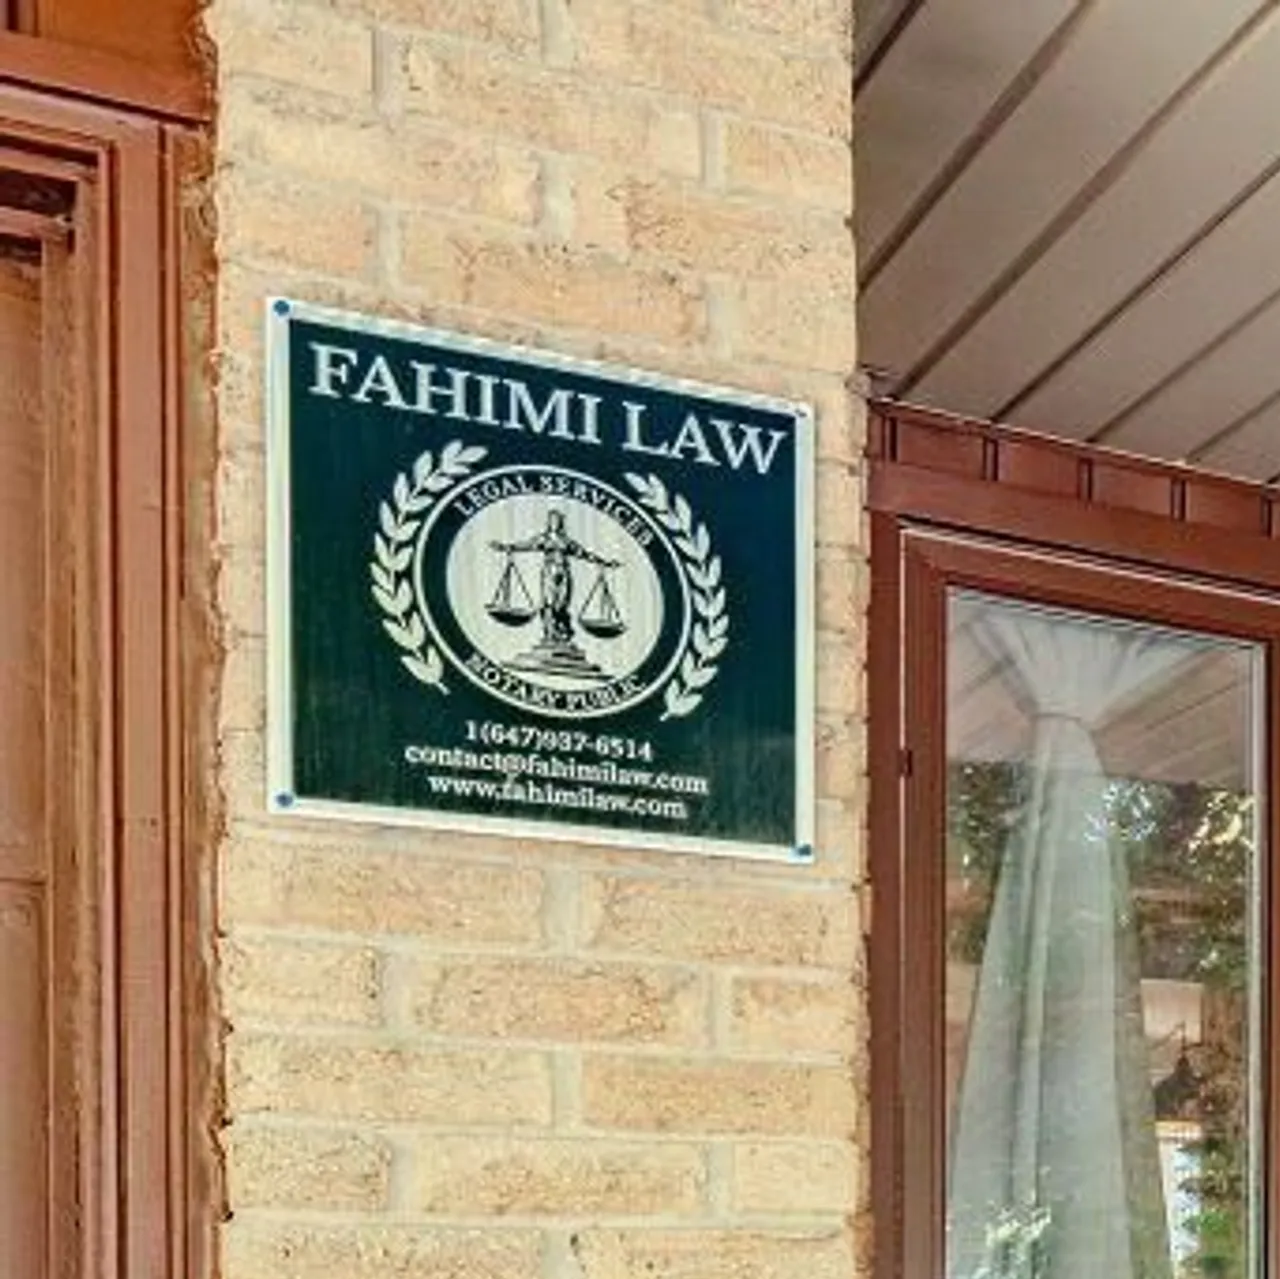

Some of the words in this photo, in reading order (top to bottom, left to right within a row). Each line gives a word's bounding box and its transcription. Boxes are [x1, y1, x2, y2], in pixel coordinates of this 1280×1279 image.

[308, 342, 602, 444] FAHIMI
[621, 400, 789, 474] LAW
[454, 475, 534, 517] LEGAL
[540, 475, 654, 546] SERVICES
[404, 745, 710, 795] contact@fahimilaw.com
[427, 773, 688, 819] www.fahimilaw.com
